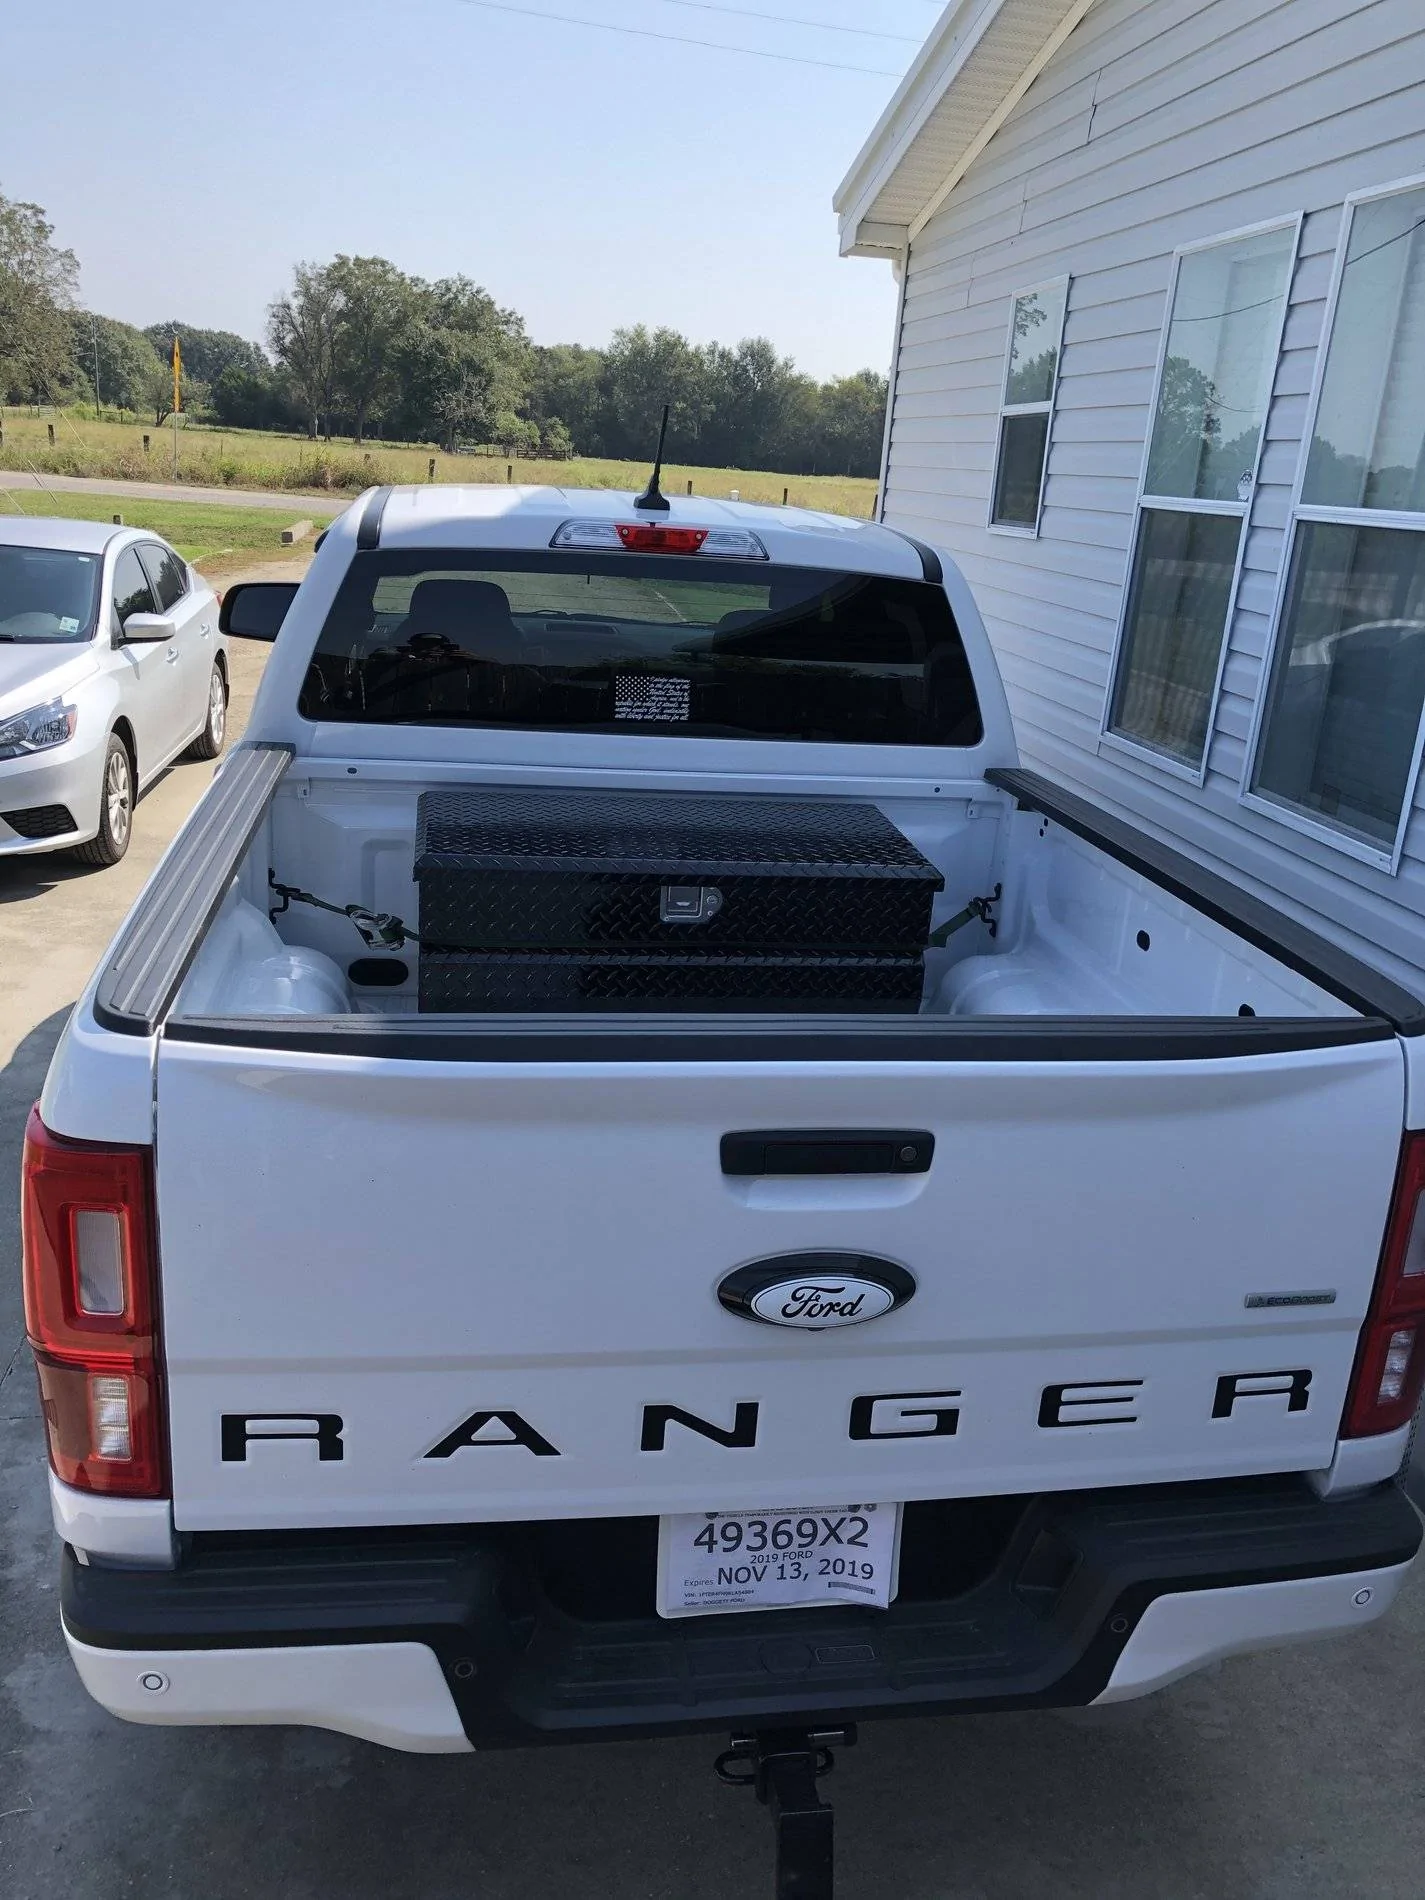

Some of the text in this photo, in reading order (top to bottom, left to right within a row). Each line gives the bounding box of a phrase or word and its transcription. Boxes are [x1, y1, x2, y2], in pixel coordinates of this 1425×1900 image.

[781, 1286, 866, 1319] Ford
[221, 1369, 1312, 1461] RANGER
[693, 1516, 870, 1554] 49369X2
[684, 1558, 874, 1587] Expires NOV 13, 2019
[751, 1550, 814, 1564] 2019 FORD
